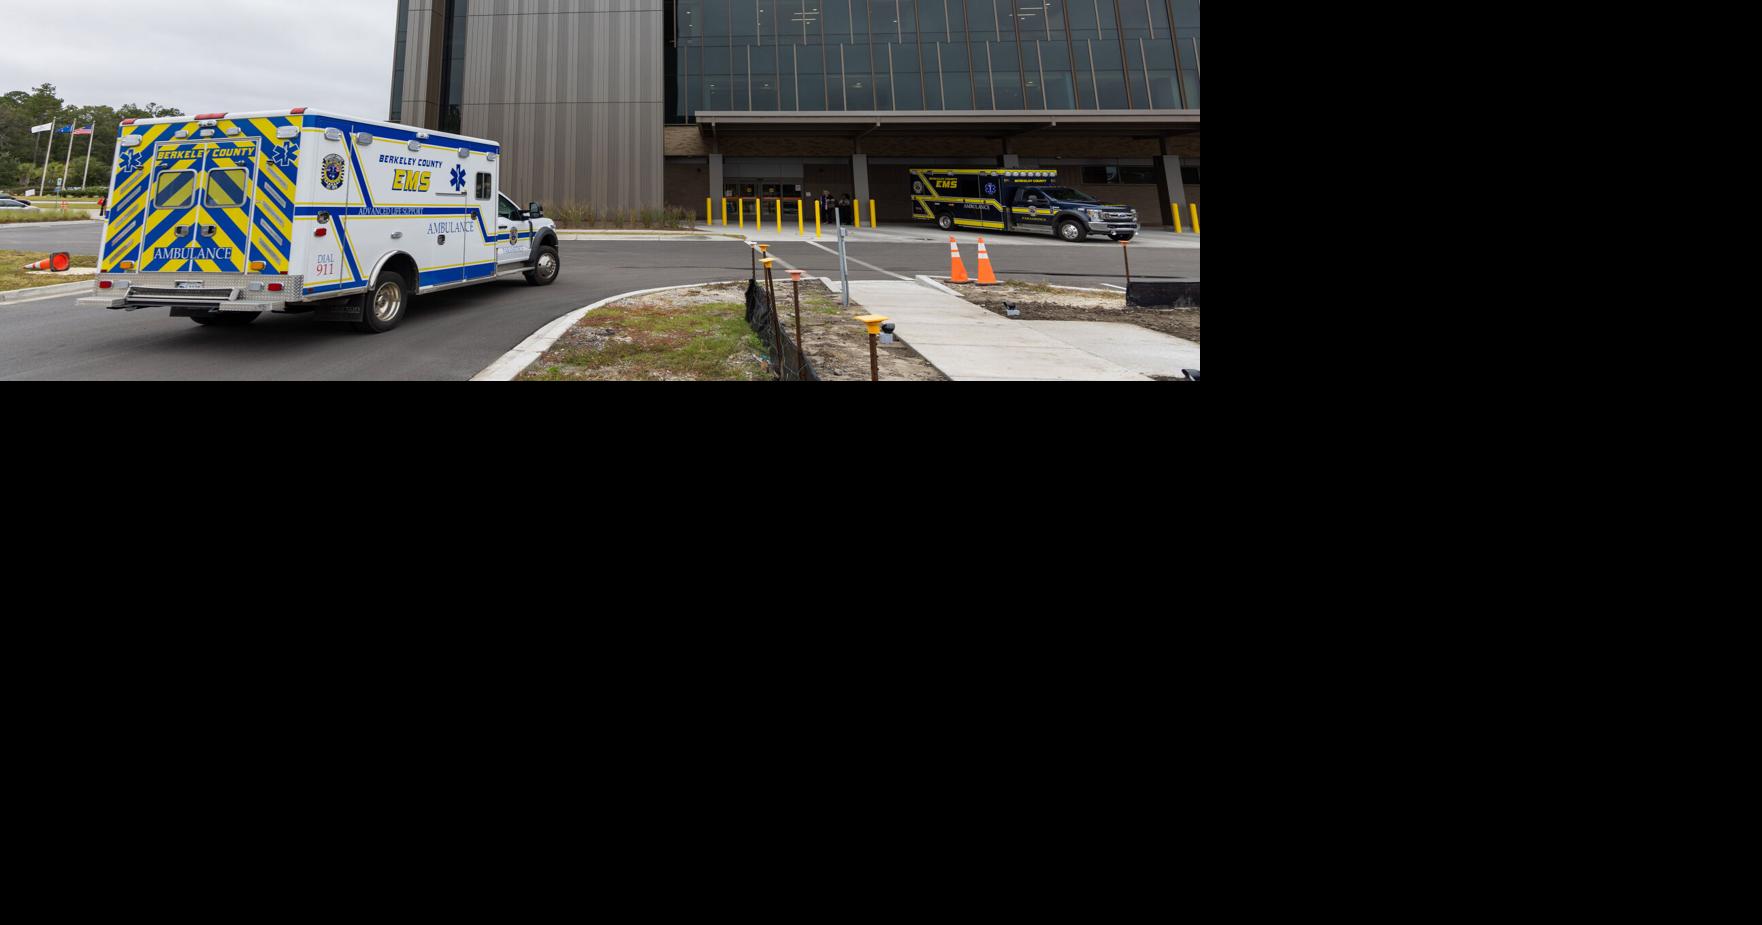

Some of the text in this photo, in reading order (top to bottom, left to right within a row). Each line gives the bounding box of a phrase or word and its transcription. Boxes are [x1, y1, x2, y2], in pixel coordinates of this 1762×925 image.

[158, 147, 255, 160] BERKELEY COUNTY
[379, 154, 443, 168] BERKELEY COUNTY
[391, 168, 432, 192] EMS
[935, 180, 958, 189] EMS
[359, 207, 391, 215] ADVANCED
[427, 221, 474, 234] AMBULANCE
[154, 247, 232, 259] AMBULANCE
[317, 253, 334, 264] DIAL
[316, 263, 333, 276] 911
